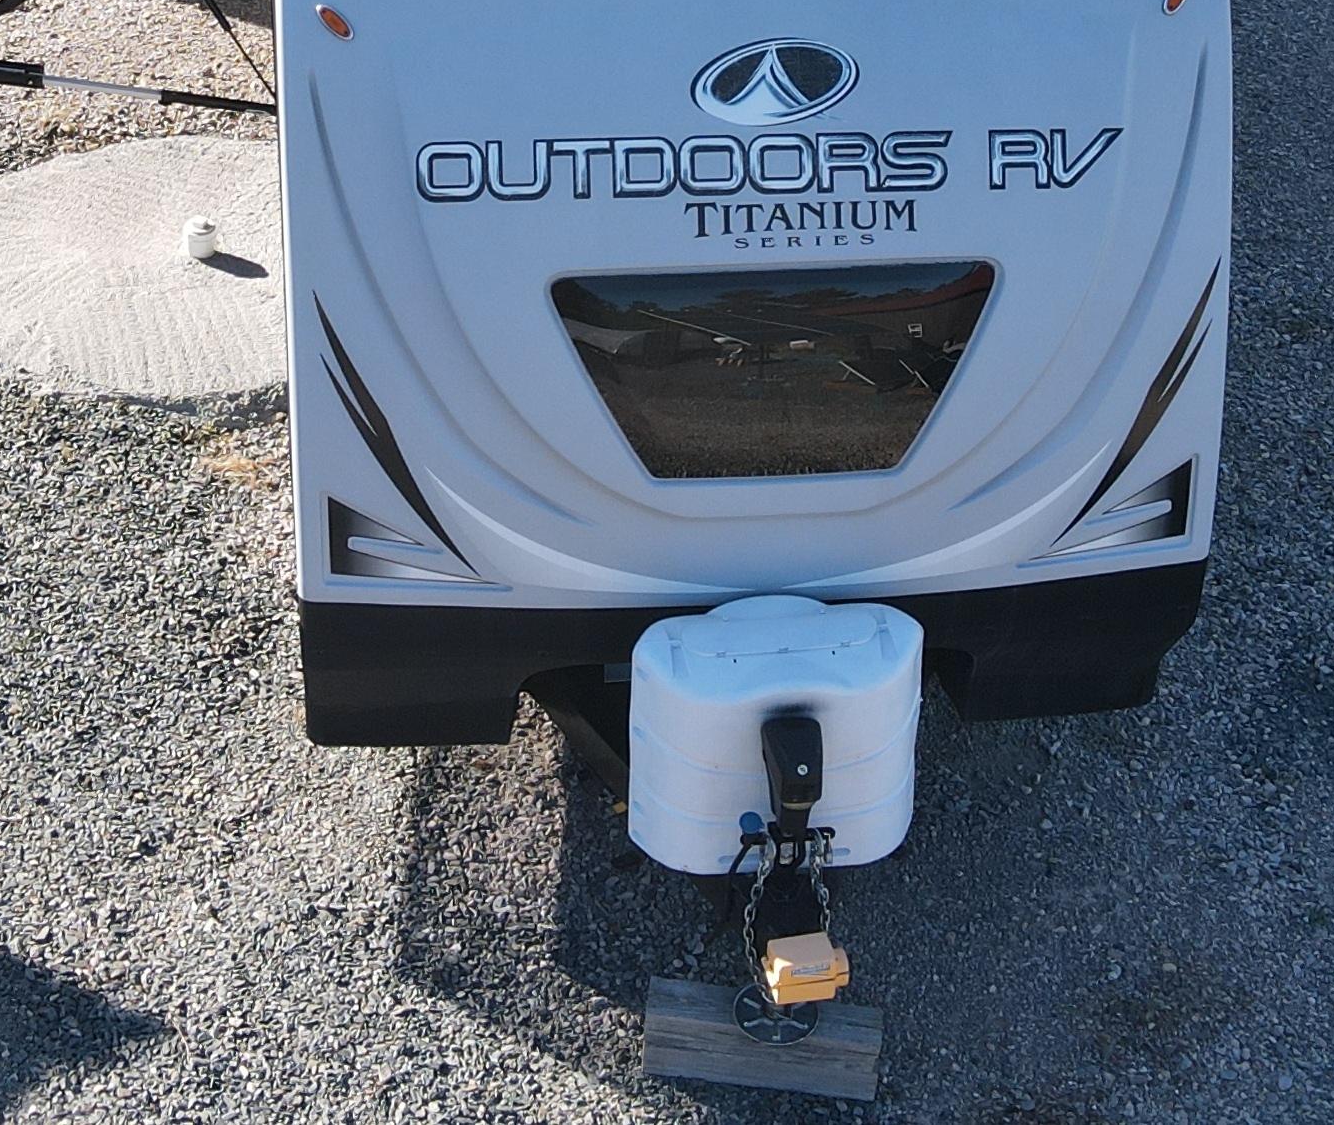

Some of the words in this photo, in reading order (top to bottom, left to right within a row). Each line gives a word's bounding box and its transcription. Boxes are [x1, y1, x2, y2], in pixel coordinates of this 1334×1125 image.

[416, 130, 954, 203] OUTDOORS
[988, 127, 1124, 191] RV
[683, 198, 918, 239] TITANIUM
[734, 233, 876, 249] SERIES
